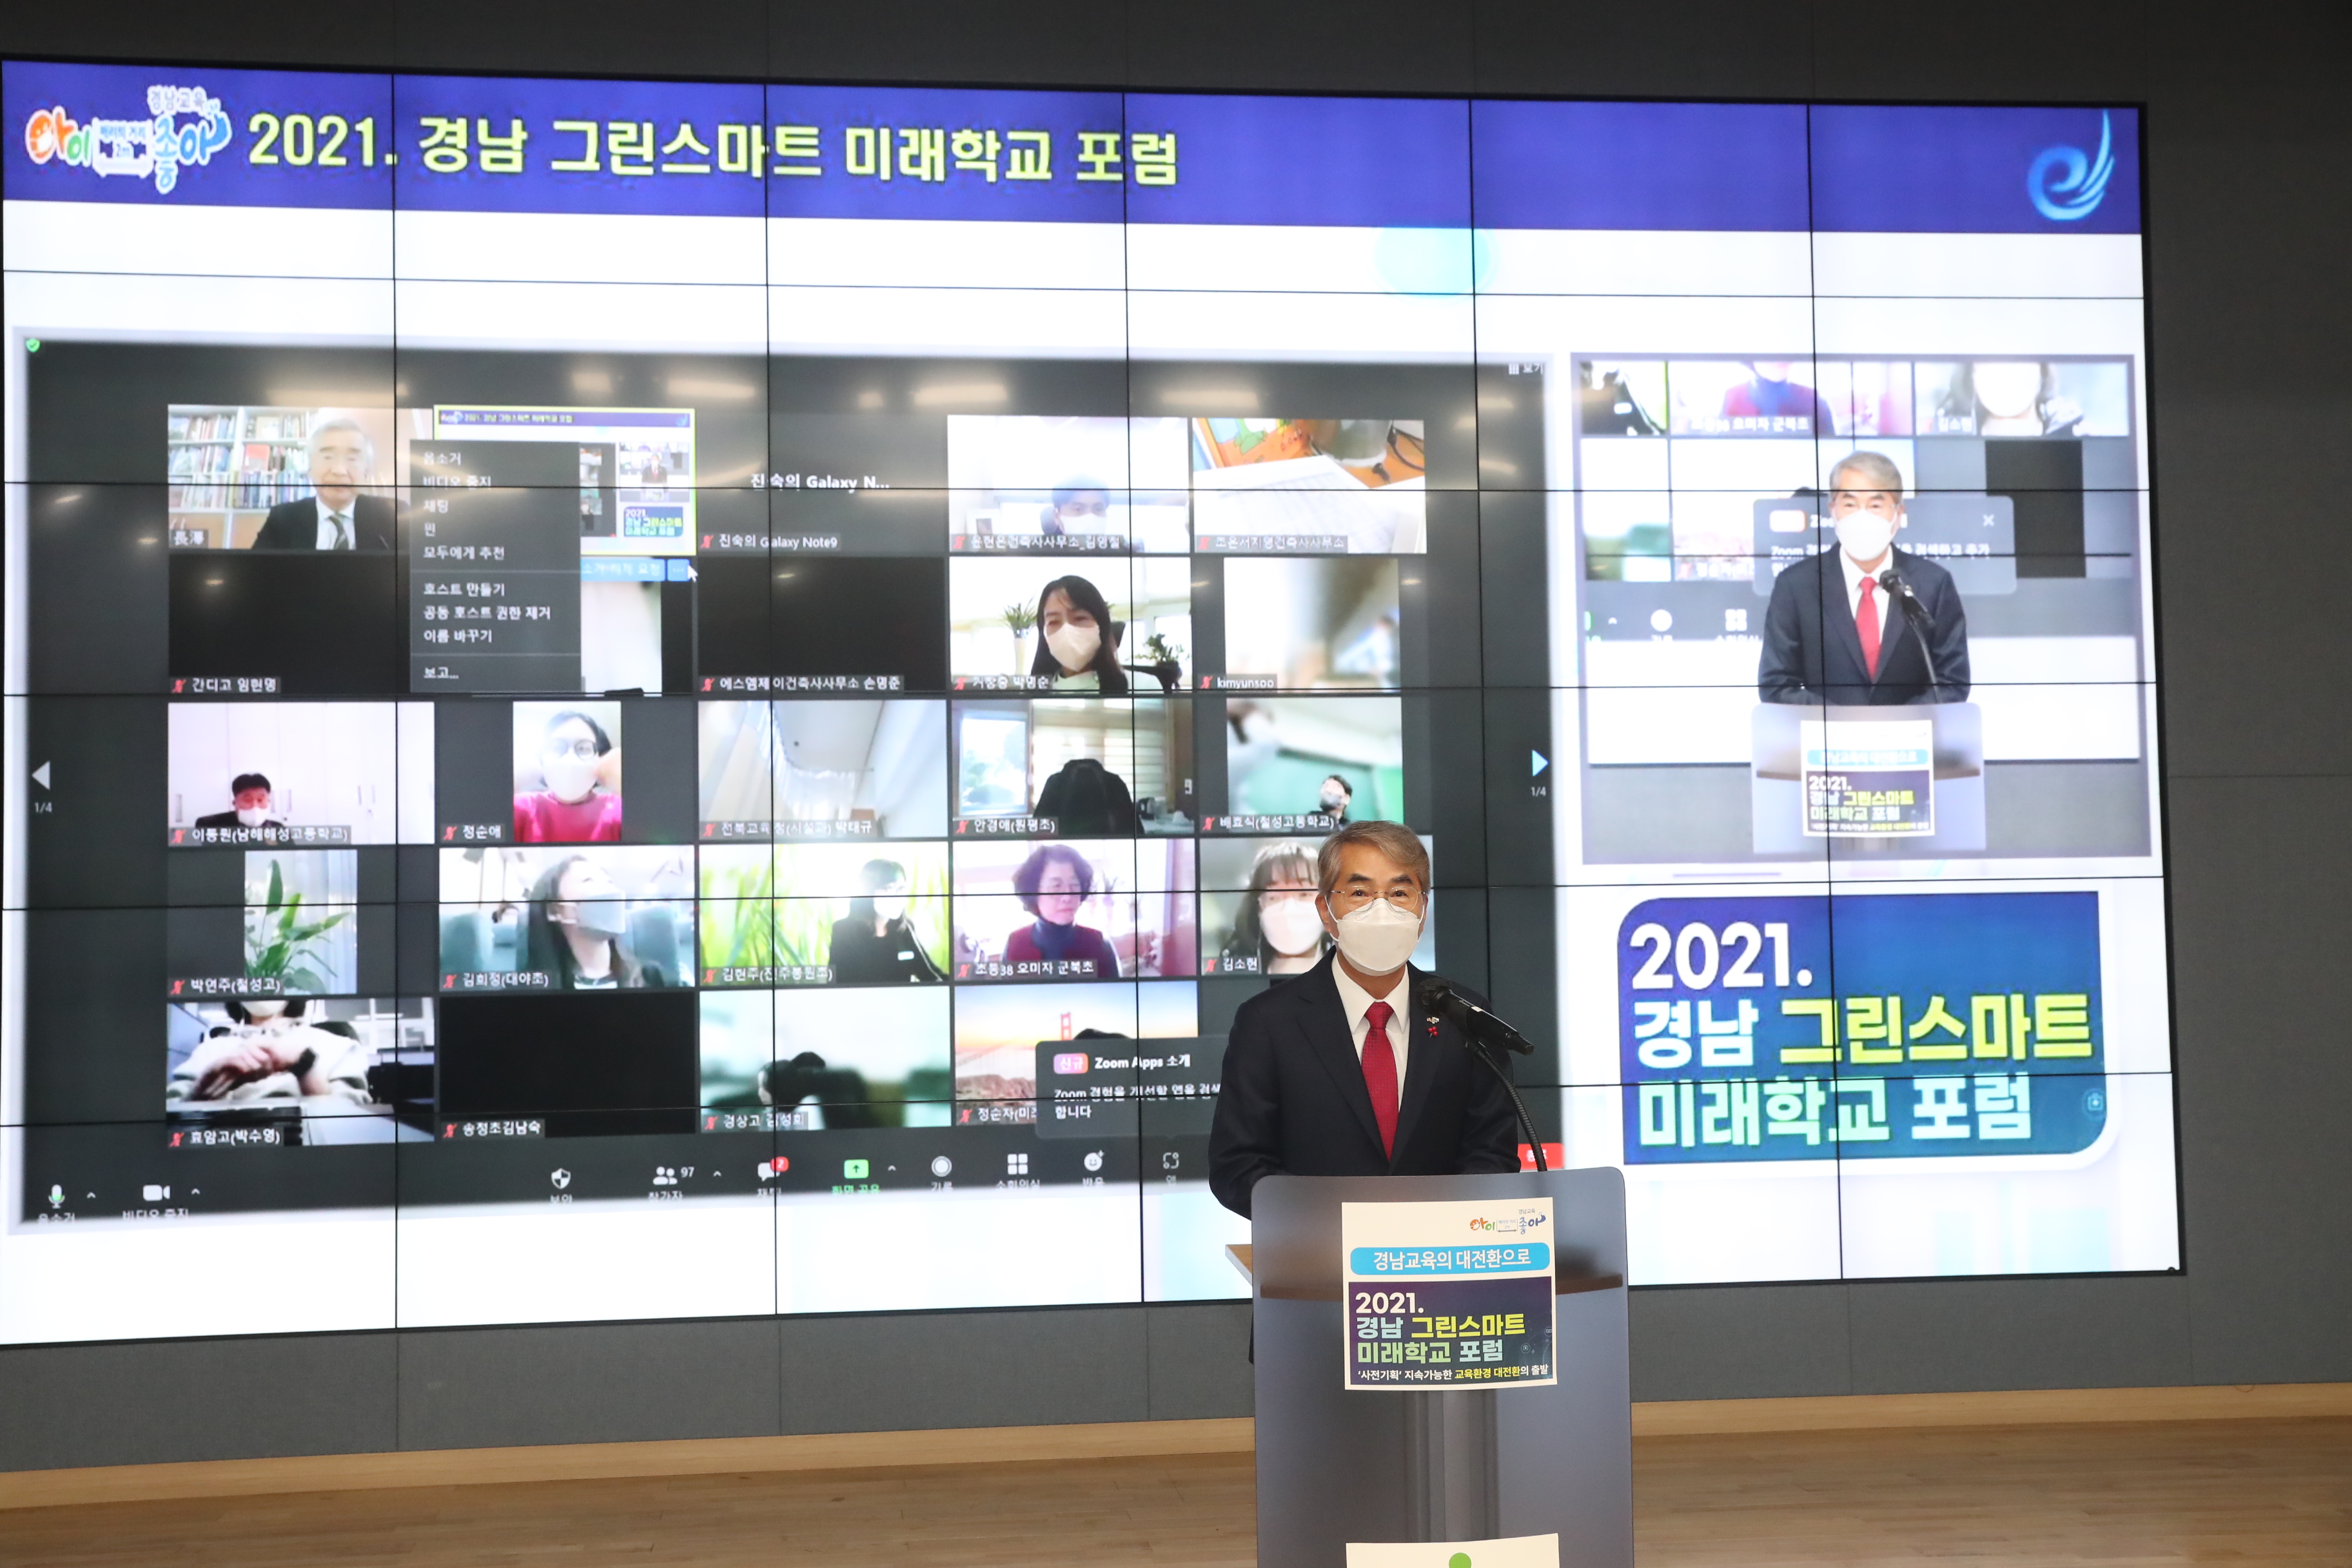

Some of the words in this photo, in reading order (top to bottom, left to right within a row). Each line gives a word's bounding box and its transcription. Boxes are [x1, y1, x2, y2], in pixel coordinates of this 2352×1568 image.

[248, 113, 398, 168] 2021.
[418, 115, 529, 175] 경남
[550, 119, 823, 180] 그린스마트
[845, 126, 1054, 183] 미래학교
[1075, 129, 1180, 187] 포럼
[424, 451, 462, 466] 음소거
[423, 475, 461, 490] 비디오
[807, 475, 858, 494] Galaxy
[719, 533, 757, 549] 진숙의
[760, 536, 799, 551] Galaxy
[802, 536, 838, 549] Note9
[423, 545, 476, 561] 모두에게
[479, 545, 505, 561] 추천
[423, 582, 463, 596] 호스트
[466, 582, 505, 598] 만들기
[424, 605, 450, 621] 공동
[454, 606, 493, 620] 호스트
[525, 605, 551, 621] 제거
[423, 629, 451, 643] 이름
[453, 629, 493, 643] 바꾸기
[1216, 676, 1275, 690] kimyunsoo
[1531, 785, 1547, 798] 1/4
[1808, 775, 1852, 791] 2021.
[1629, 921, 1813, 991] 2021.
[1016, 961, 1054, 975] 오미자
[1633, 998, 1760, 1070] 경남
[1778, 993, 2093, 1065] 그린스마트
[1059, 1056, 1084, 1071] 신규
[1094, 1057, 1129, 1070] Zoom
[1132, 1056, 1164, 1071] Apps
[1166, 1054, 1191, 1068] 소개
[1054, 1088, 1087, 1102] Zoom
[1090, 1085, 1126, 1102] 경험을
[1054, 1104, 1092, 1120] 합니다
[1638, 1075, 1892, 1148] 미래학교
[1910, 1072, 2033, 1141] 포럼
[680, 1166, 695, 1179] 97
[1373, 1251, 1452, 1271] 경남교육의
[1456, 1248, 1531, 1269] 대전환으로
[1355, 1292, 1424, 1314] 2021.
[1356, 1317, 1404, 1340] 경남
[1411, 1313, 1526, 1339] 그린스마트
[1357, 1341, 1451, 1364] 미래학교
[1459, 1339, 1504, 1363] 포럼
[1404, 1369, 1453, 1381] 지속가능한
[1455, 1367, 1492, 1380] 교육환경
[1494, 1366, 1529, 1378] 대전환의
[1531, 1364, 1549, 1377] 출발
